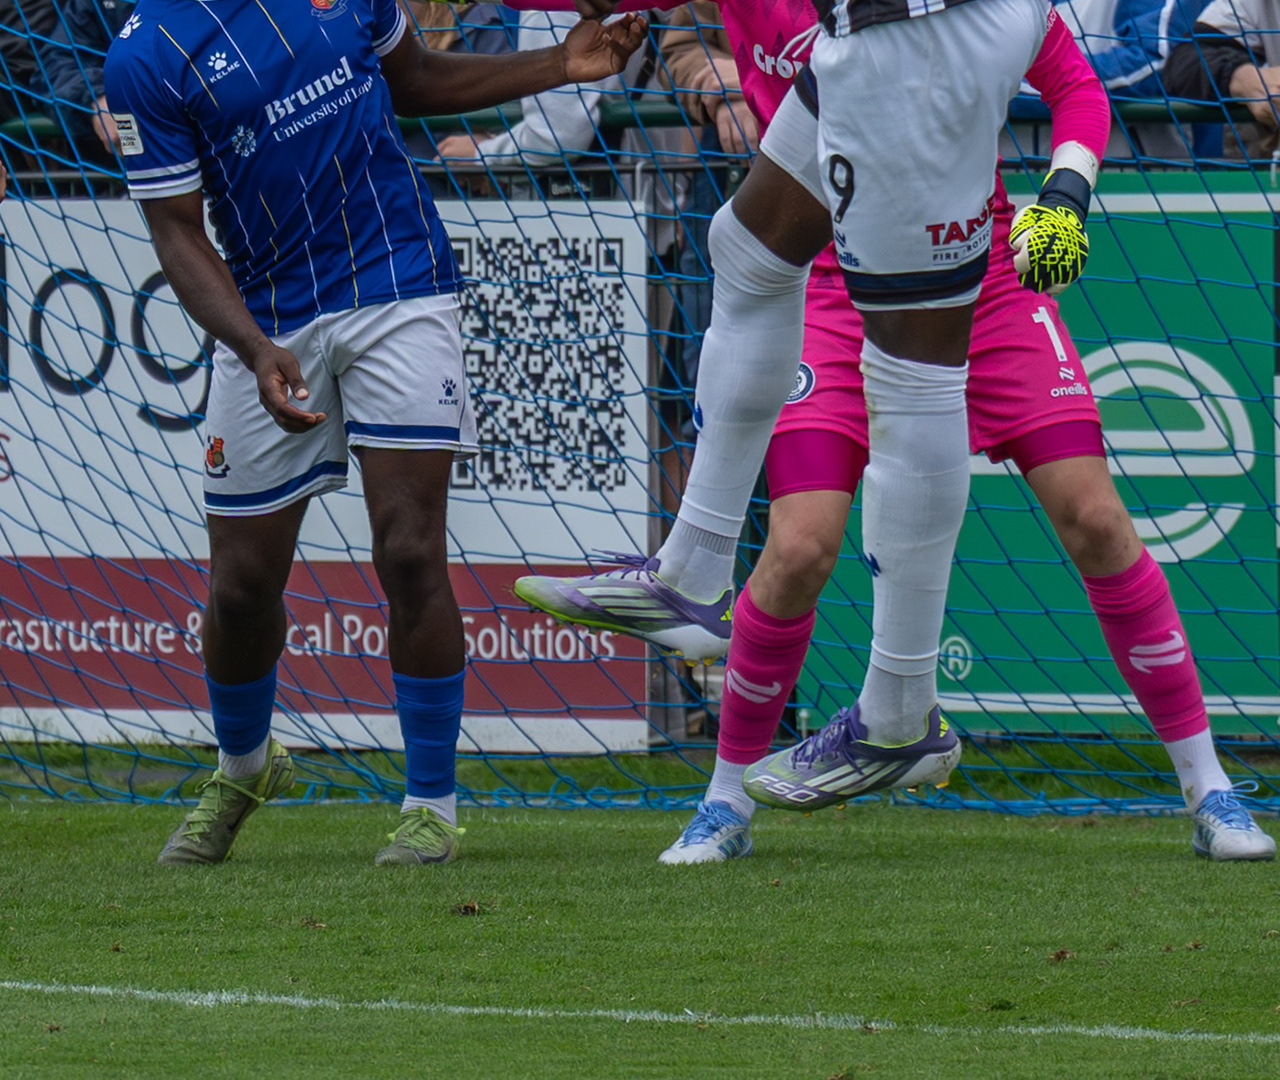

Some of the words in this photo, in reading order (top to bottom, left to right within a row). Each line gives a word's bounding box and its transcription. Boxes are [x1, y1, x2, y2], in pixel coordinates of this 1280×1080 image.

[209, 60, 241, 84] KELME
[753, 43, 803, 79] Cro
[264, 55, 355, 126] Brunel
[272, 98, 339, 143] University
[338, 88, 352, 107] of
[350, 75, 374, 101] Lon
[828, 153, 855, 224] 9
[837, 252, 860, 268] eills
[932, 251, 959, 262] FIRE
[1031, 306, 1068, 362] 1
[1050, 382, 1088, 397] oneills
[464, 617, 616, 663] Solutions
[748, 774, 819, 803] F50
